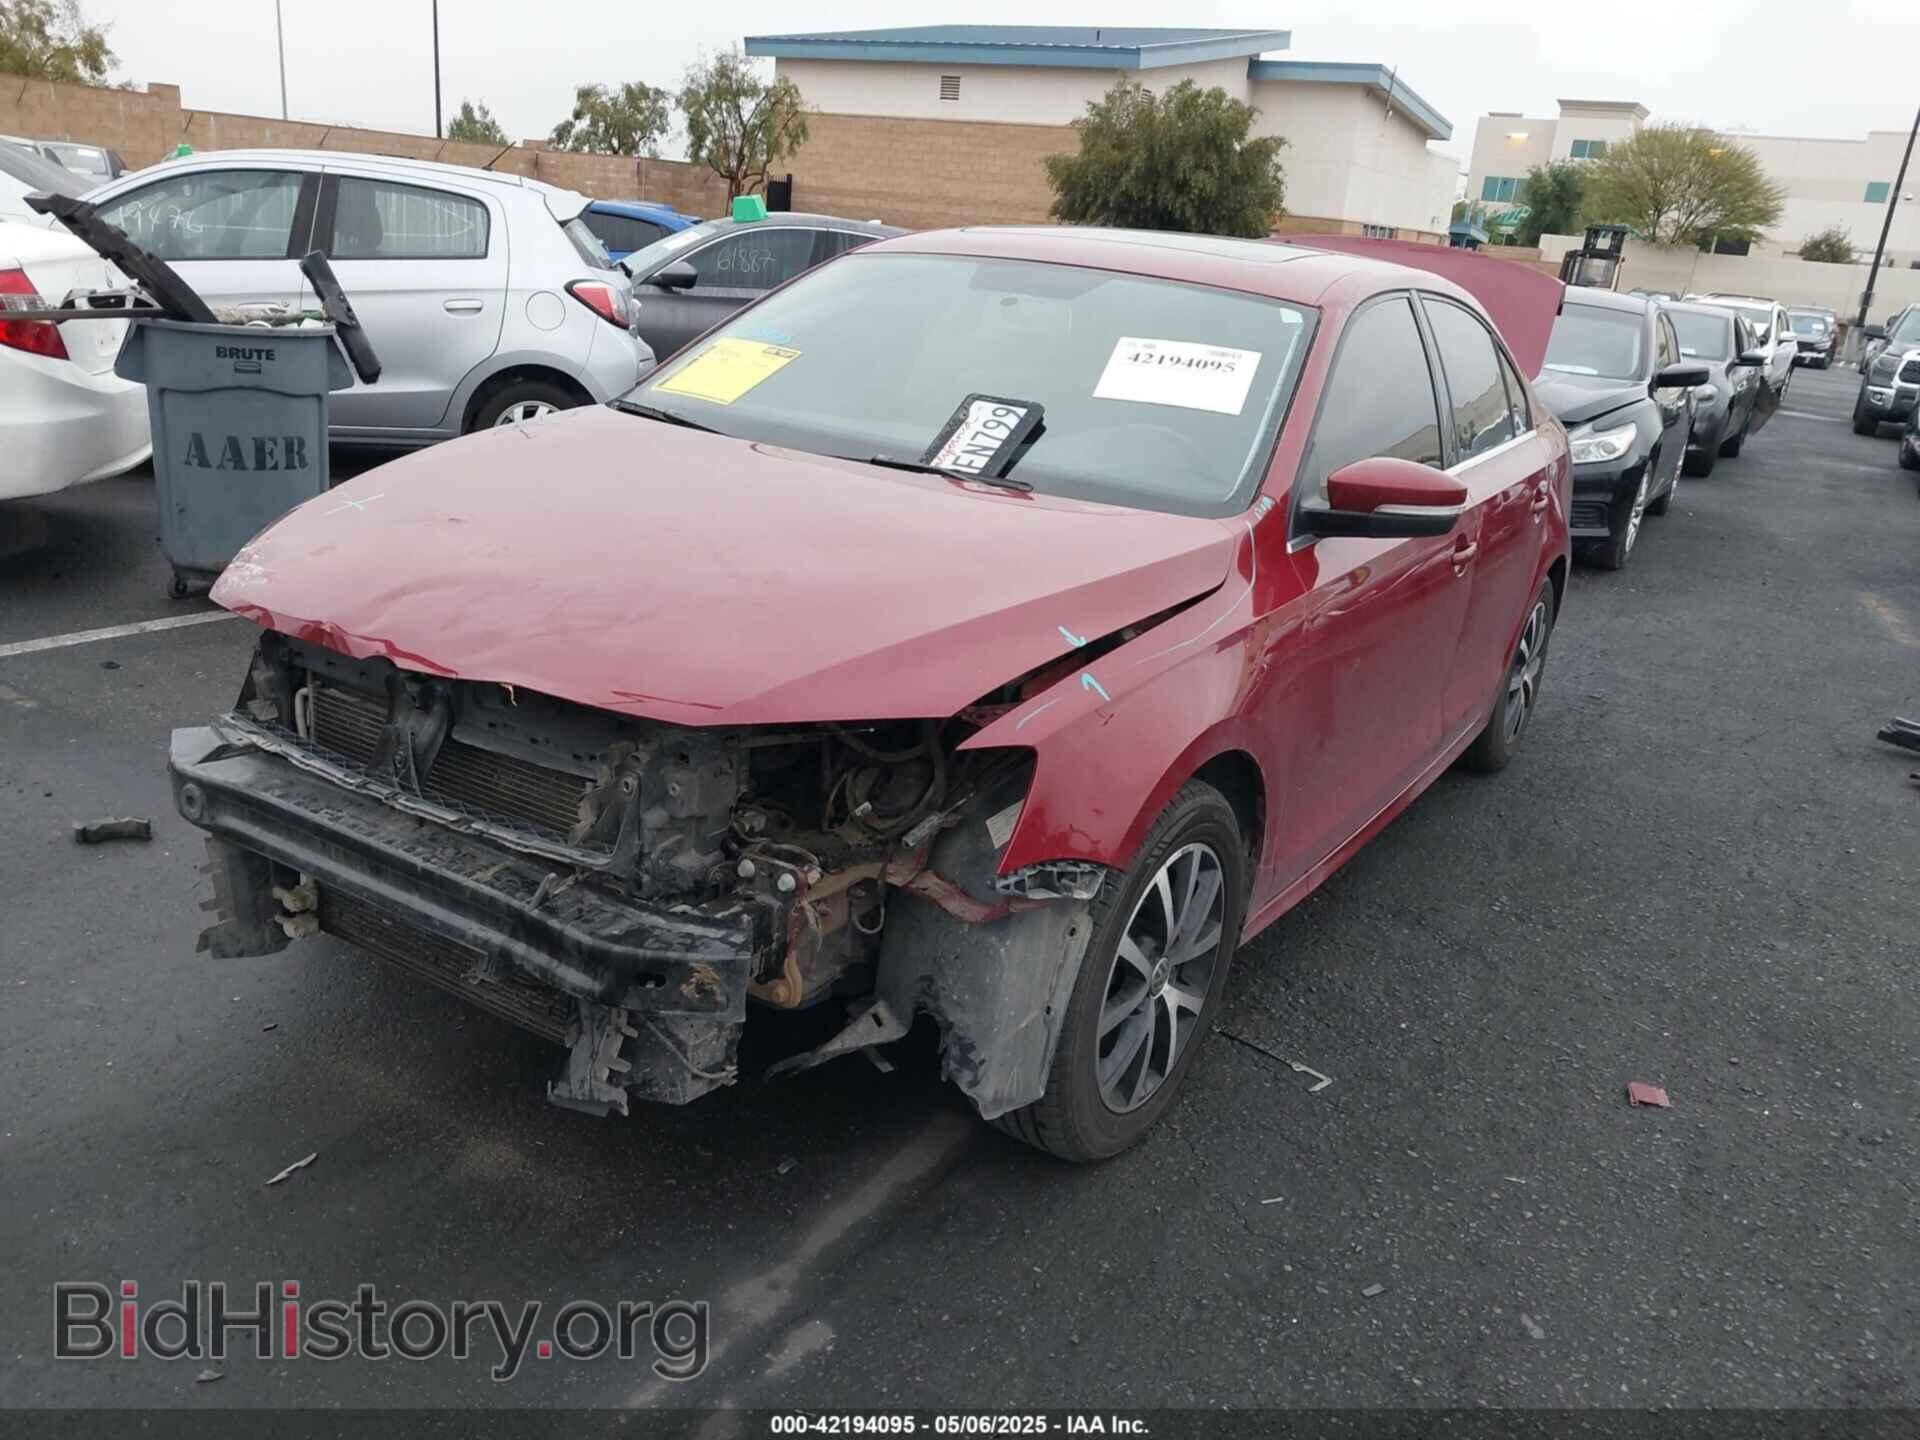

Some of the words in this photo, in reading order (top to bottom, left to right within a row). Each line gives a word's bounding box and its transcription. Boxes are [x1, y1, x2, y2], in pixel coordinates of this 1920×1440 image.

[216, 345, 276, 361] BRUTE
[1127, 352, 1237, 373] 42194095
[184, 432, 309, 471] AAER
